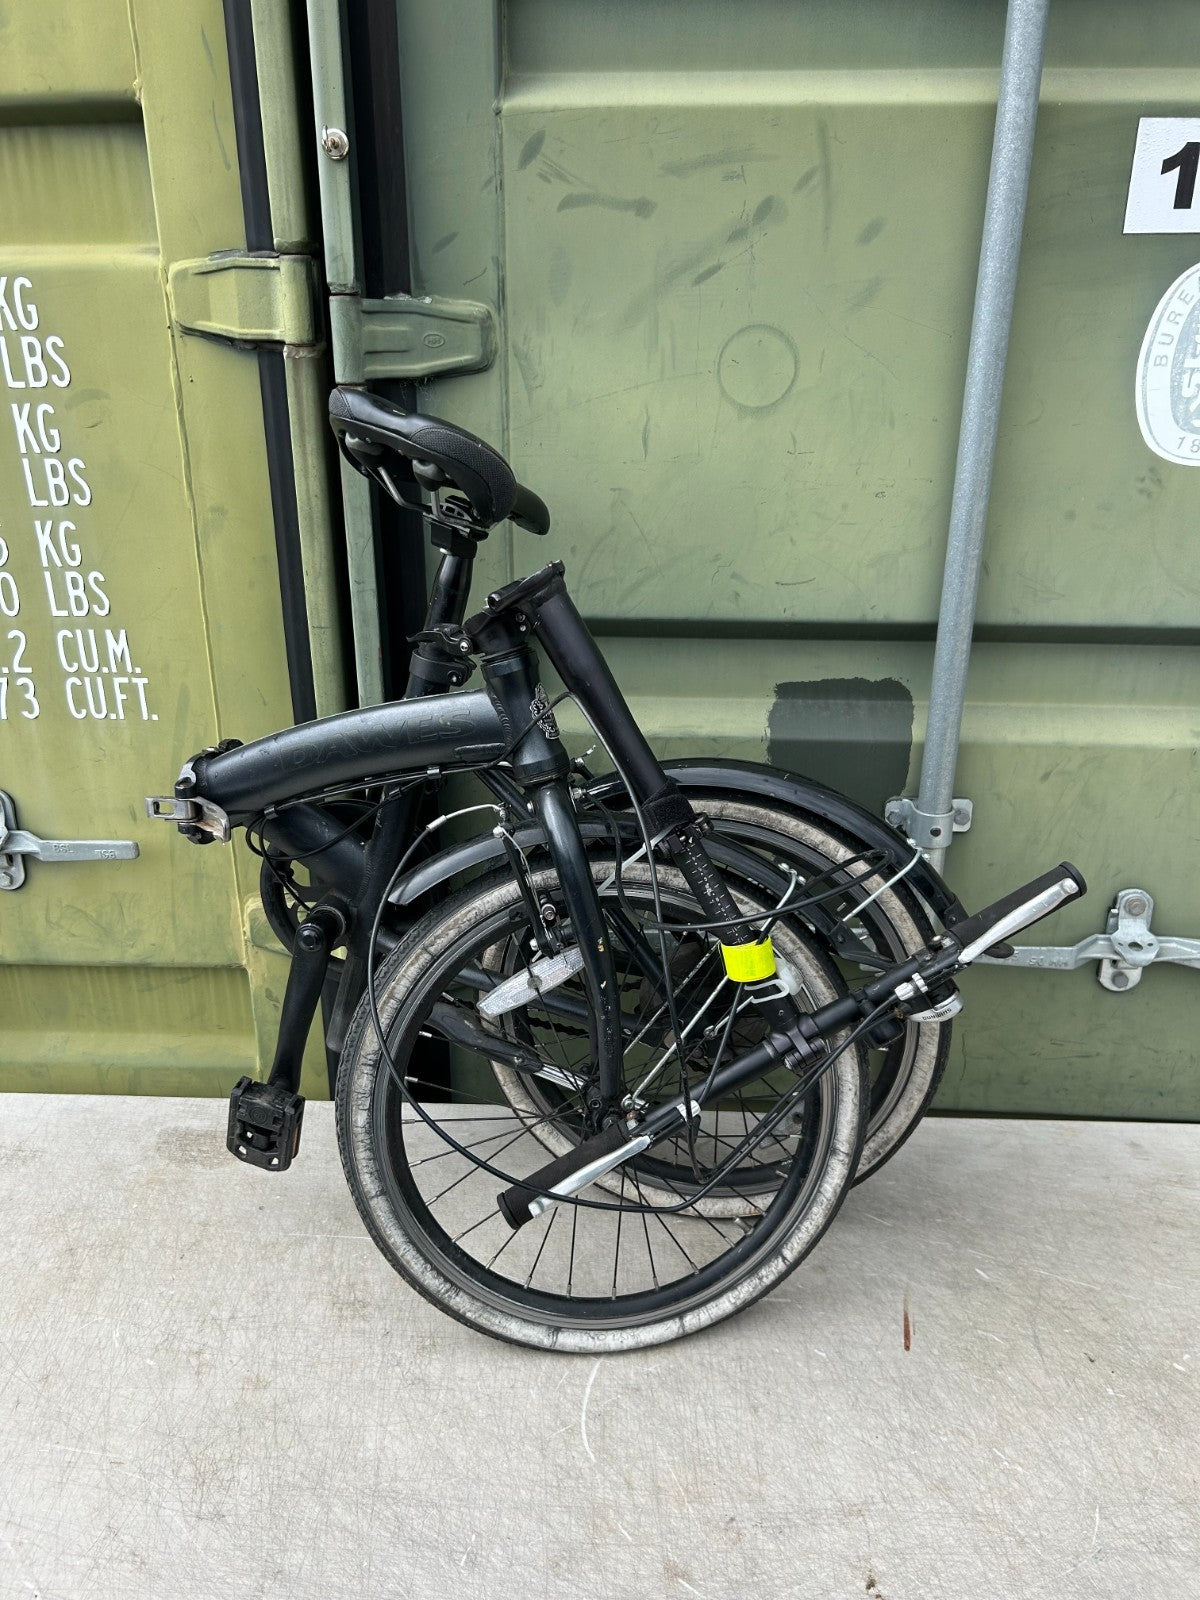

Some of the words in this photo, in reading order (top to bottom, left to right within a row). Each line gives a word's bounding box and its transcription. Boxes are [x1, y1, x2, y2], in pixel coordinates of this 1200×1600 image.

[1161, 142, 1200, 209] 1
[0, 277, 39, 330] KG
[1154, 279, 1200, 367] BURE
[0, 336, 71, 388] LBS
[12, 403, 61, 453] KG
[22, 458, 91, 506] LBS
[34, 520, 82, 567] KG
[44, 571, 110, 617] LBS
[57, 629, 141, 673] CU.M.
[66, 677, 158, 720] CU.FT.
[280, 709, 475, 773] DAWES
